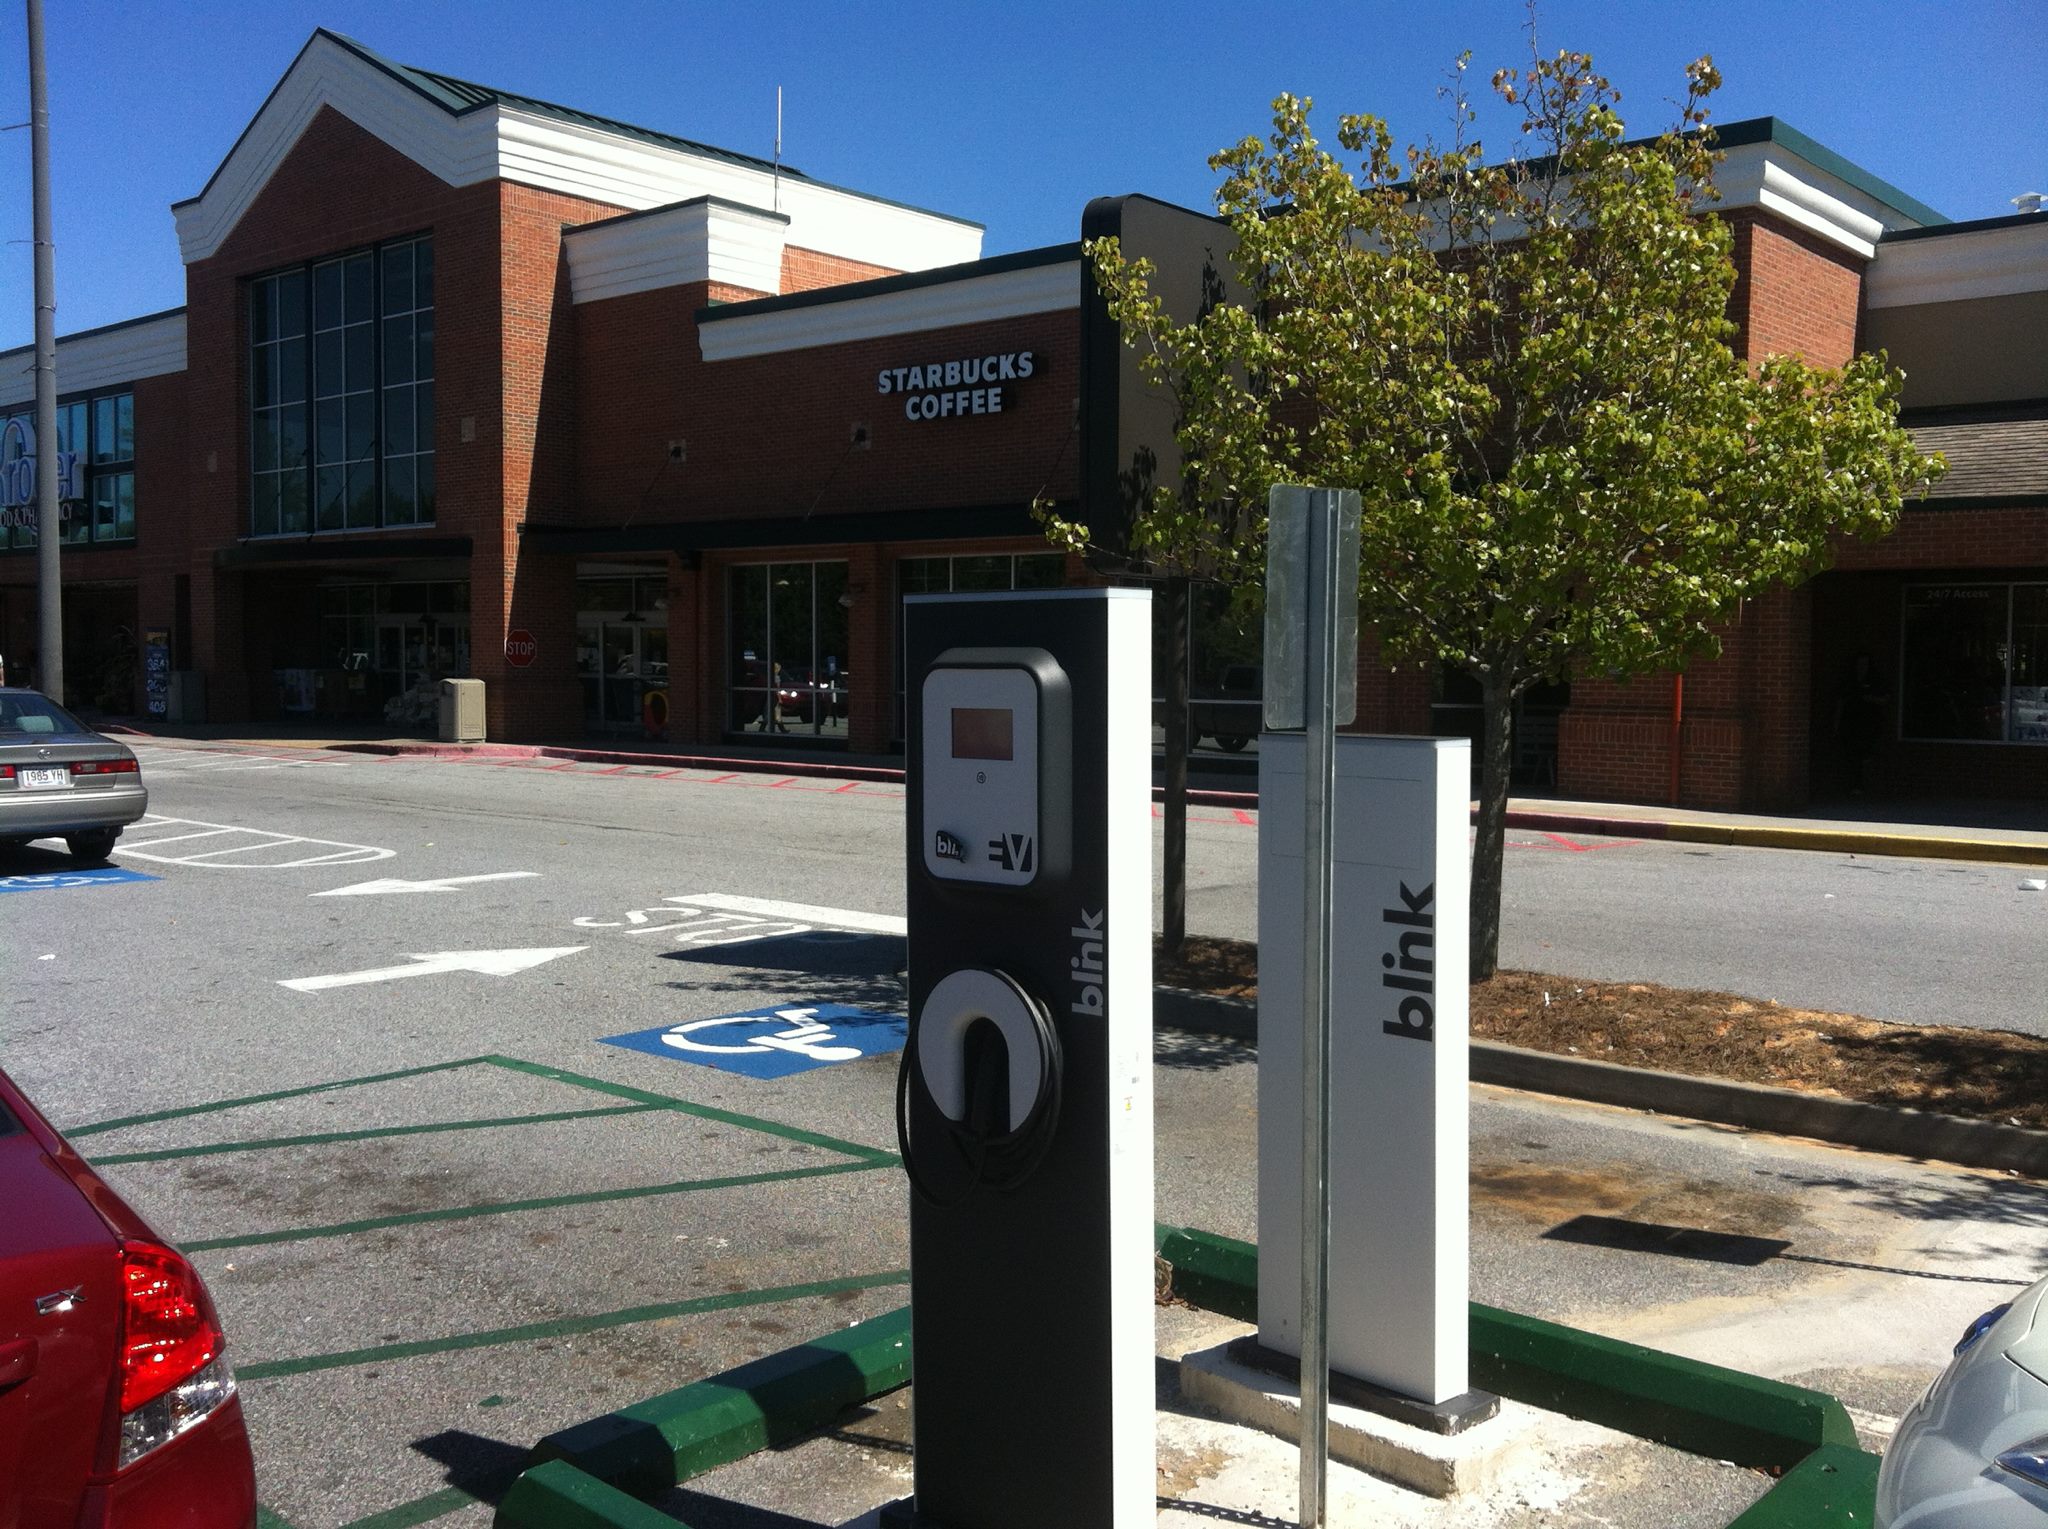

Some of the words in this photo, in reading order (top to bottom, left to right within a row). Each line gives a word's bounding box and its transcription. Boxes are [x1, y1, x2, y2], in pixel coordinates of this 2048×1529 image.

[878, 351, 1034, 394] STARBUCKS
[905, 387, 1002, 421] COFFEE
[507, 641, 535, 656] STOP
[25, 771, 49, 782] 1985
[51, 769, 64, 781] YH
[989, 832, 1032, 873] EV
[1071, 907, 1104, 1017] blink
[1382, 879, 1433, 1042] blink
